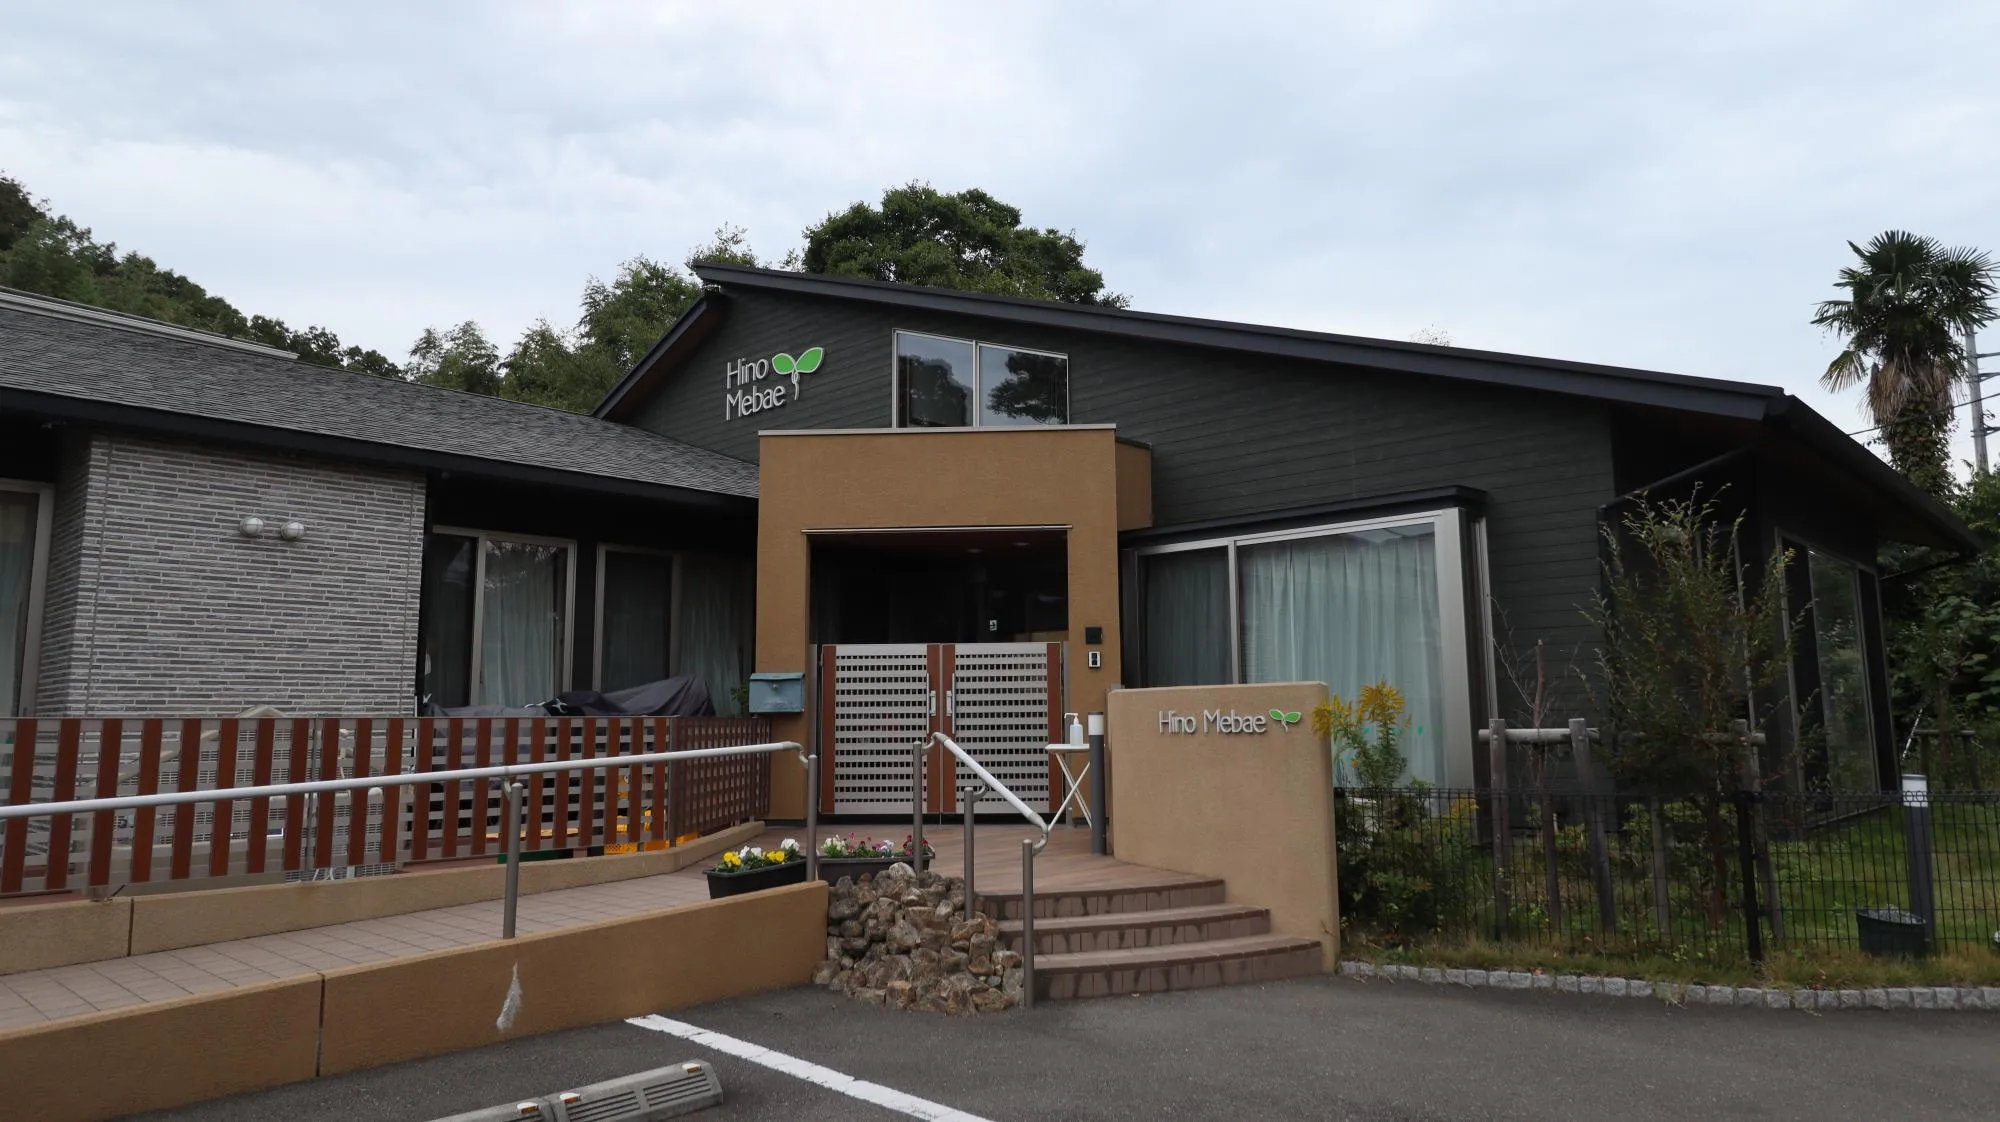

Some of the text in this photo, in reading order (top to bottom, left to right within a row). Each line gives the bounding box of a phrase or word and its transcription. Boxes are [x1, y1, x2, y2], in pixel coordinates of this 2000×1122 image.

[727, 358, 768, 389] Hino
[726, 385, 785, 420] Mebae
[1159, 709, 1266, 733] Hino Mebae
